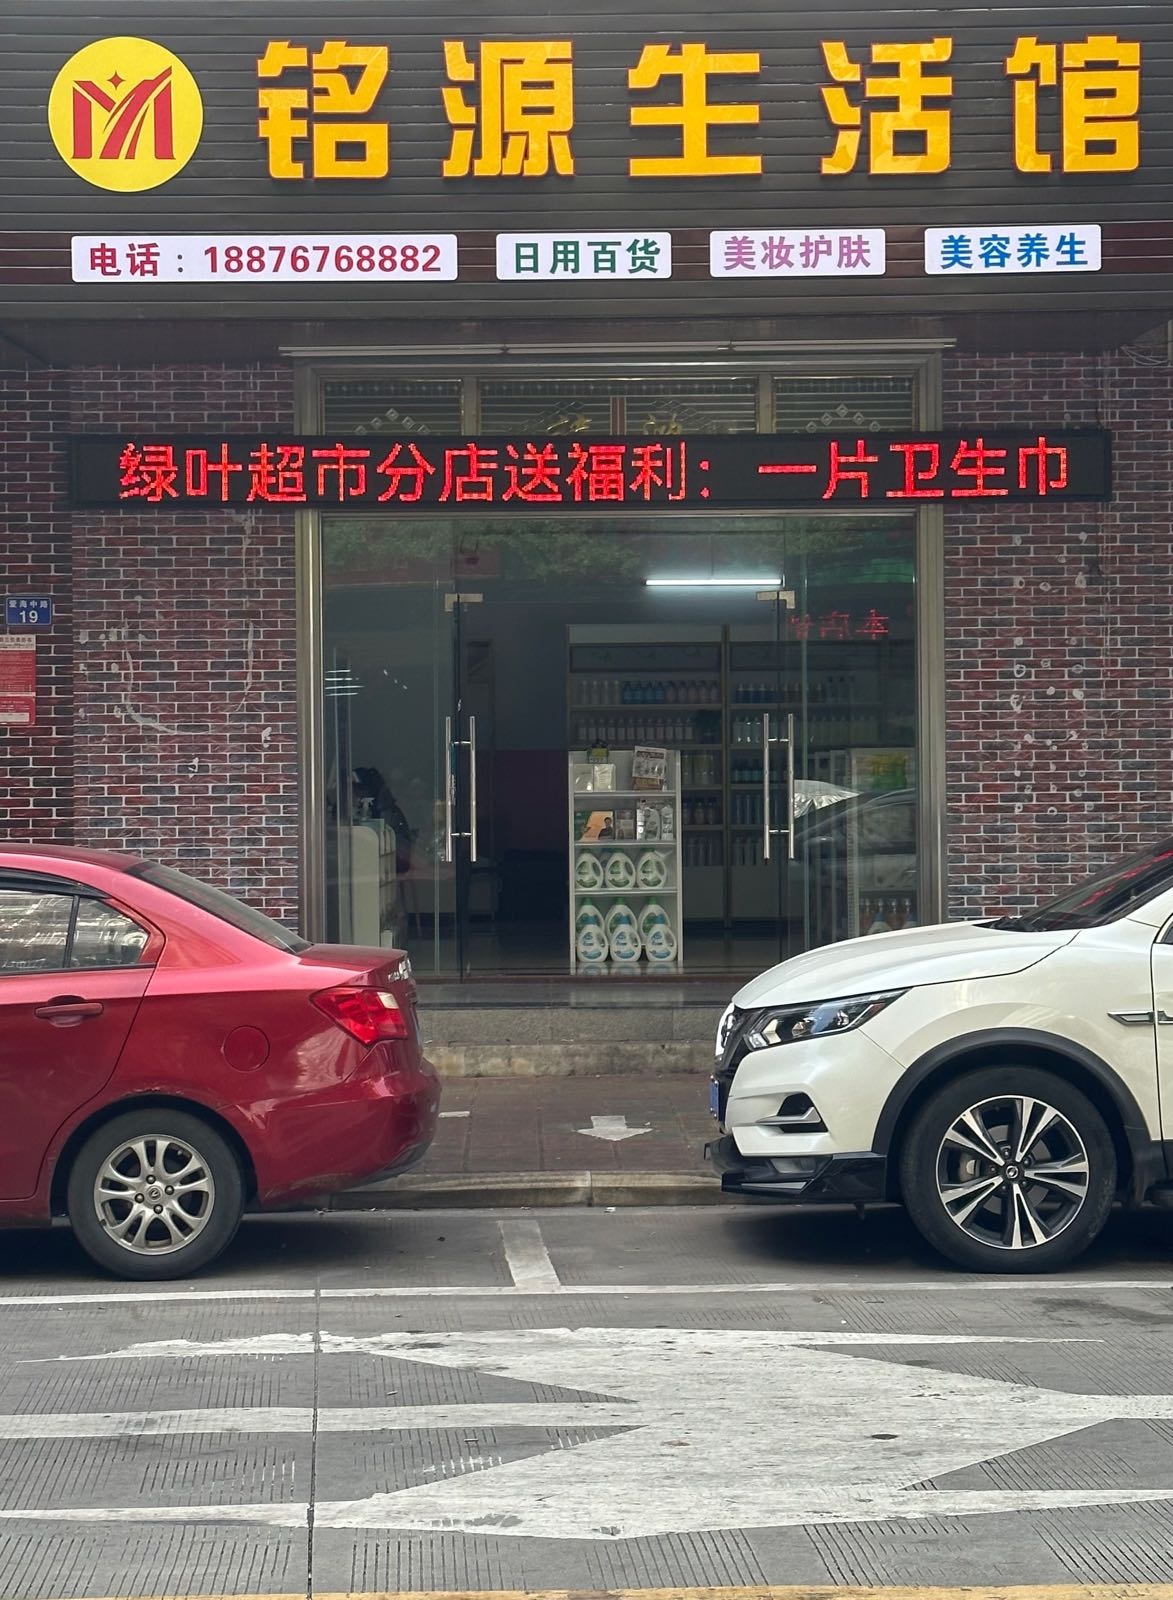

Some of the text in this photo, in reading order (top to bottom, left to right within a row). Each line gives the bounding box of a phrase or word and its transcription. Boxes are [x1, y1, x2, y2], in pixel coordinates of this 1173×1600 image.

[257, 35, 1141, 180] 铭源生活馆
[514, 238, 661, 275] 日用百货
[723, 235, 872, 271] 美妆护肤
[940, 233, 1089, 269] 美容养生
[19, 610, 39, 624] 19
